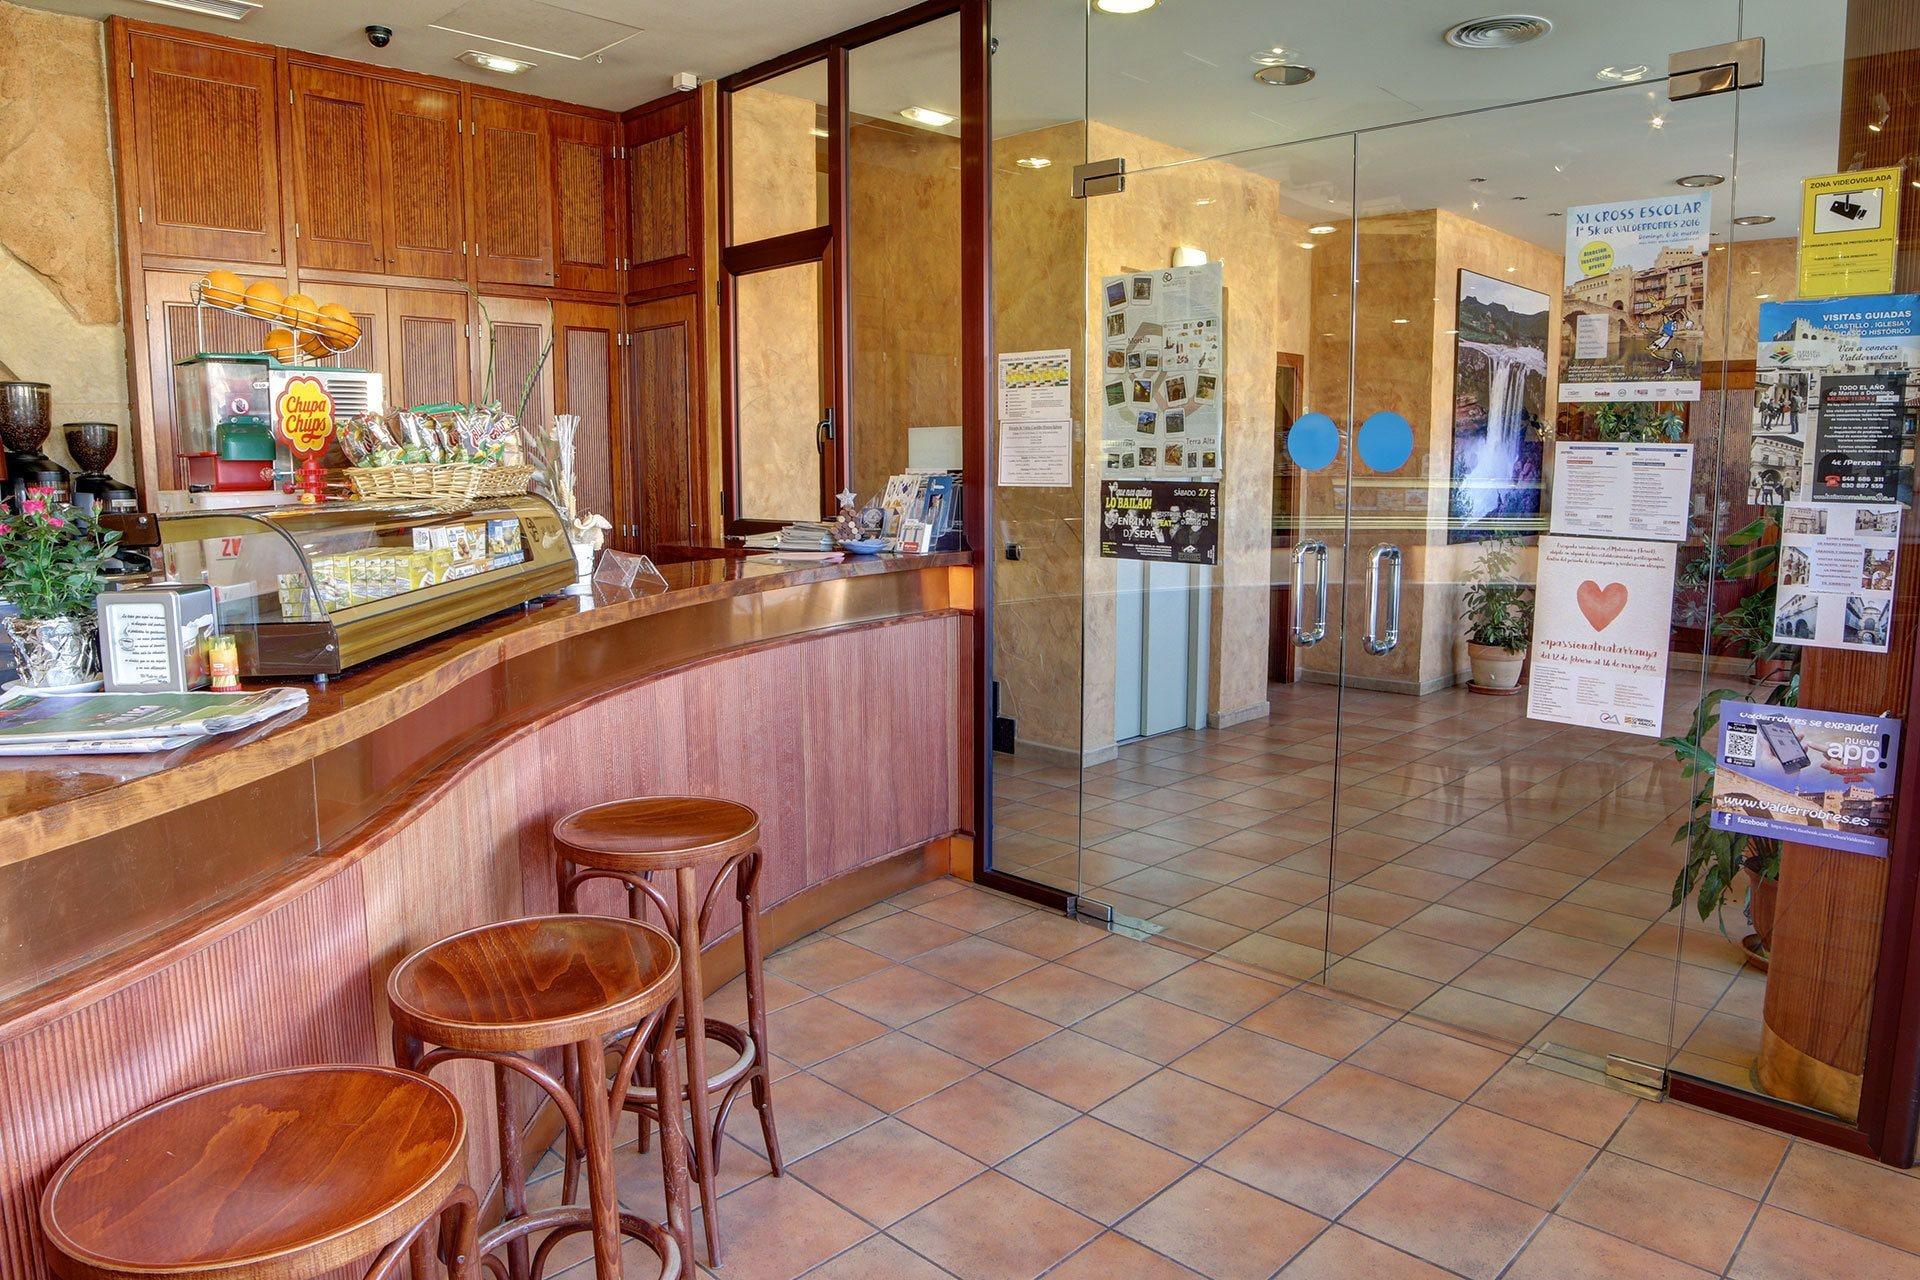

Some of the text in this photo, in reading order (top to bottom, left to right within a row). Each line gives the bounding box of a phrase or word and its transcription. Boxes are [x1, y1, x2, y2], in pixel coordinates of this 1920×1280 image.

[1810, 174, 1892, 189] ZONA VIDEOVIGILADA
[1576, 201, 1702, 225] XI CROSS ESCOLAR
[1604, 227, 1614, 235] DE
[1616, 221, 1678, 233] VALDERROBRES
[1681, 219, 1700, 228] 2016
[1823, 310, 1912, 321] VISITAS GUIADAS
[1833, 322, 1869, 330] CASTILLO
[1868, 327, 1911, 336] HISTÓRICO
[1838, 344, 1854, 353] Ven
[1865, 344, 1899, 352] conocer
[1840, 353, 1898, 363] Valderrobres
[286, 396, 327, 418] Chupa
[285, 415, 327, 443] Chups
[1173, 488, 1196, 496] SÁBADO
[1105, 498, 1152, 509] LO BAILAO!
[1134, 530, 1156, 538] SEPE
[1560, 653, 1568, 661] de
[1612, 659, 1620, 667] de
[1740, 712, 1879, 735] Valderrobres se expande!!
[1844, 735, 1879, 746] nueva
[1737, 816, 1769, 828] facebook
